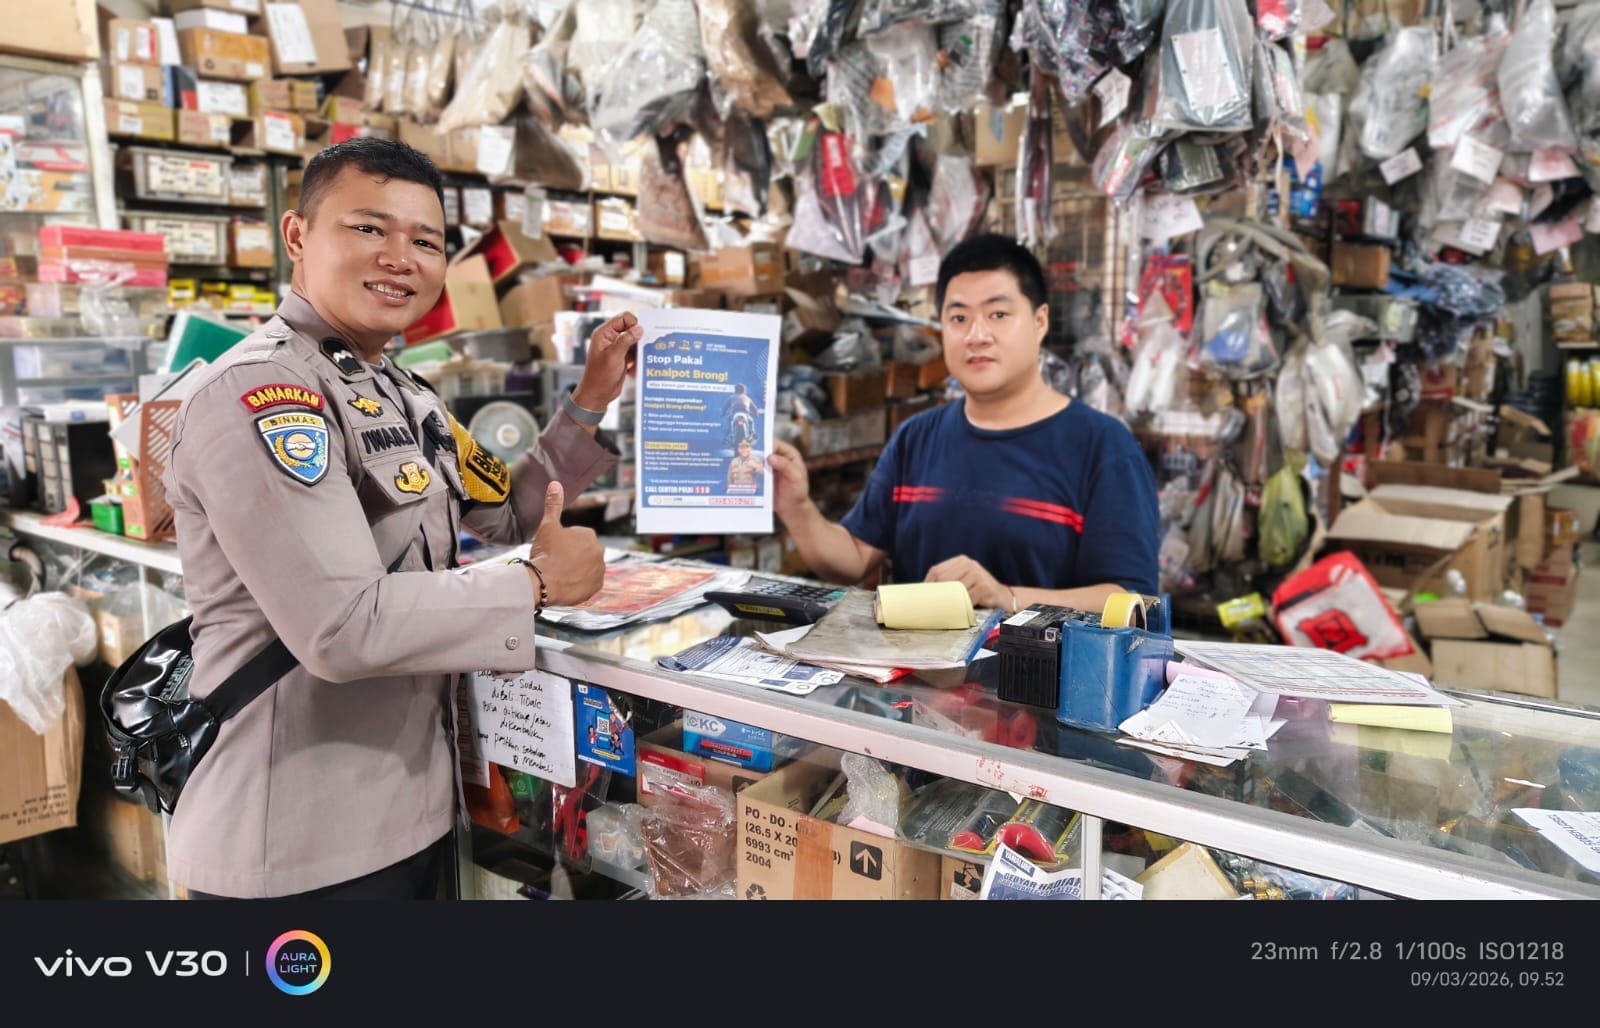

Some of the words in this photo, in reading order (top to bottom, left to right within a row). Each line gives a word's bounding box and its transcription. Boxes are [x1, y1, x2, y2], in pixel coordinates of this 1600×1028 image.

[646, 355, 671, 365] Stop
[674, 355, 703, 366] Pakai
[646, 368, 691, 380] Knalpot
[693, 369, 729, 383] Brong!
[248, 386, 320, 408] BAHARKAM
[269, 415, 316, 427] BINMAS
[745, 806, 760, 819] PO
[769, 813, 786, 828] DO
[745, 821, 772, 839] (26.5
[745, 836, 771, 854] 6993
[745, 851, 772, 870] 2004
